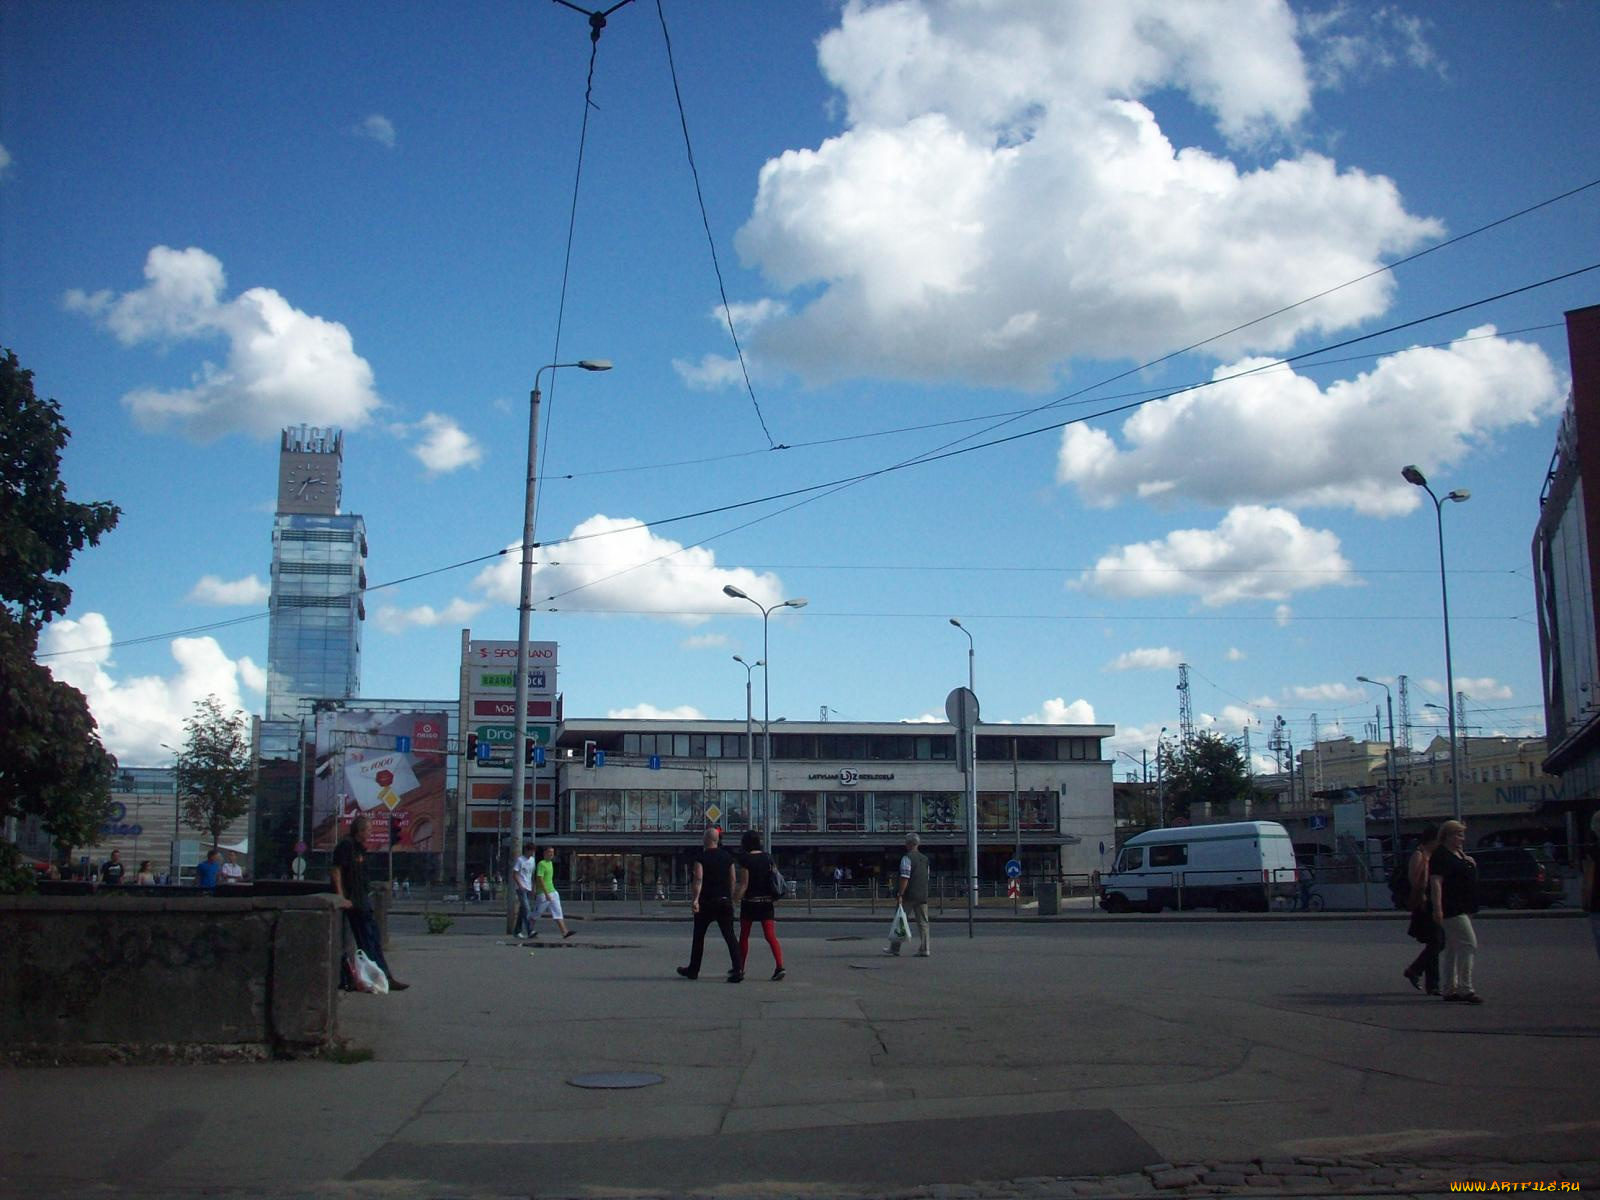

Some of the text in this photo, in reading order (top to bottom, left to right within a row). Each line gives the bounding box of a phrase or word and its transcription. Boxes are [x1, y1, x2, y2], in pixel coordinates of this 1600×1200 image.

[494, 648, 553, 659] SPOLAND
[370, 757, 394, 770] 1000
[98, 824, 143, 836] RIGO
